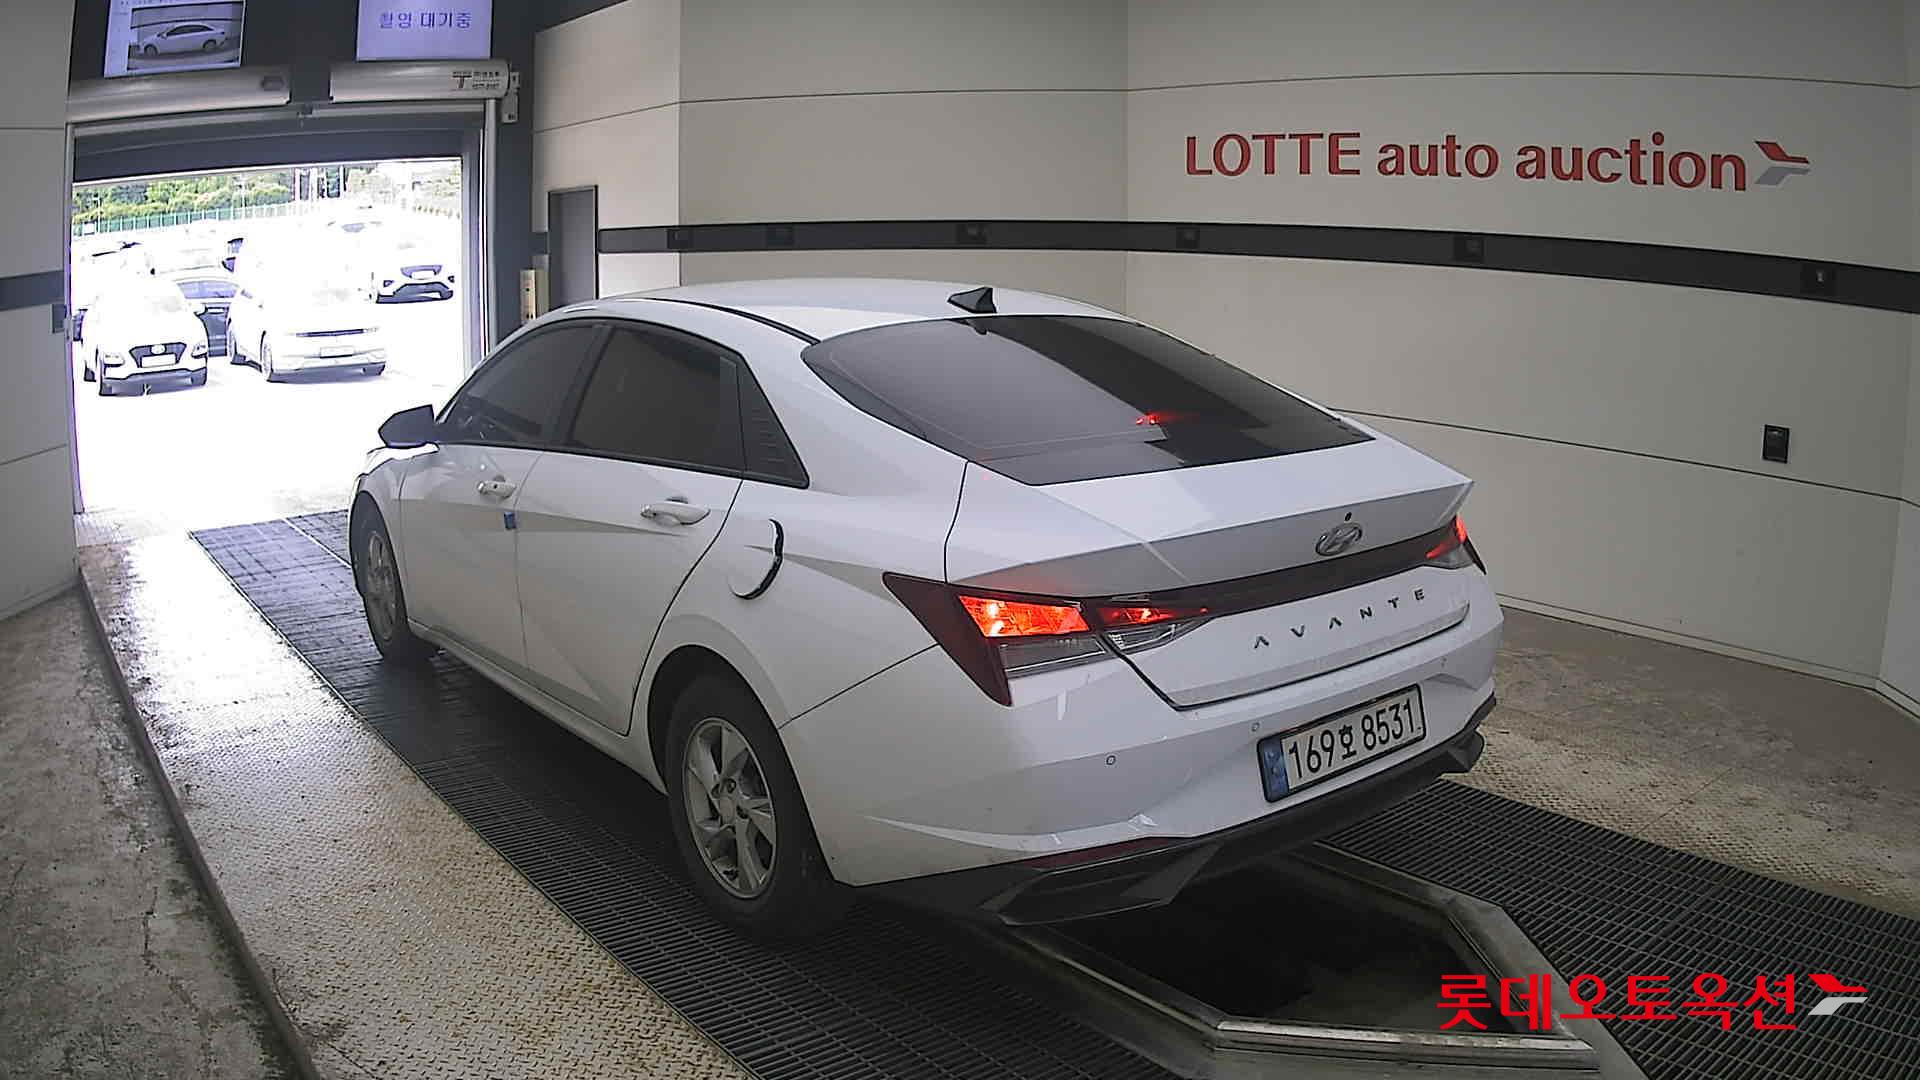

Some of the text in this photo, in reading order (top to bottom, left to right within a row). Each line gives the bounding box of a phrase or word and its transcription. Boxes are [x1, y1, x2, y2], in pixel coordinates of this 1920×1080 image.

[420, 11, 472, 29] 대기중
[1186, 131, 1747, 191] LOTTE auto auction
[1253, 588, 1426, 650] AVANTE
[1287, 698, 1417, 779] 169호 8531
